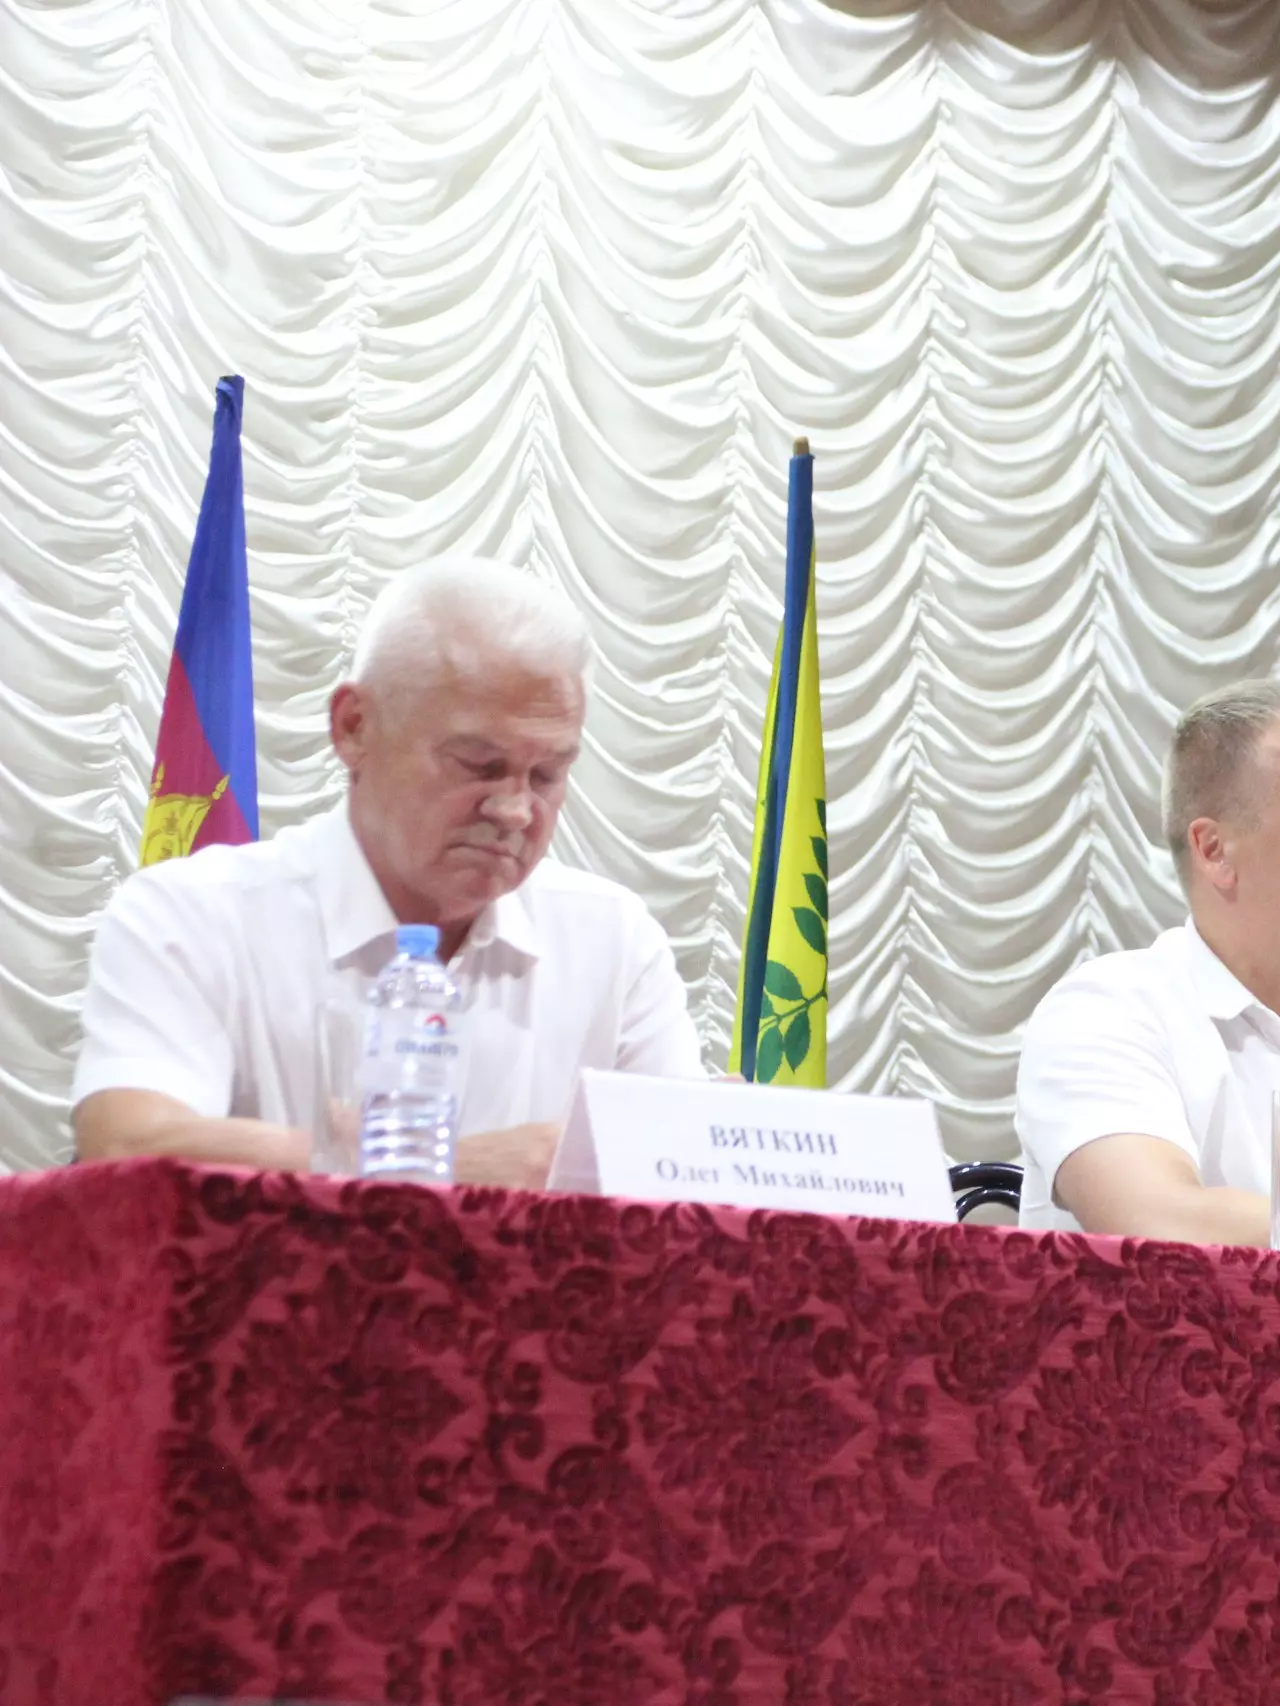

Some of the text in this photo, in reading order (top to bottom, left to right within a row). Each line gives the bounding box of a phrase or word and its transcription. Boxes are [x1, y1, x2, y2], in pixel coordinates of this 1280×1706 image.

[709, 1125, 838, 1156] ВЯТКИН
[655, 1159, 905, 1198] Олег Михайлович
